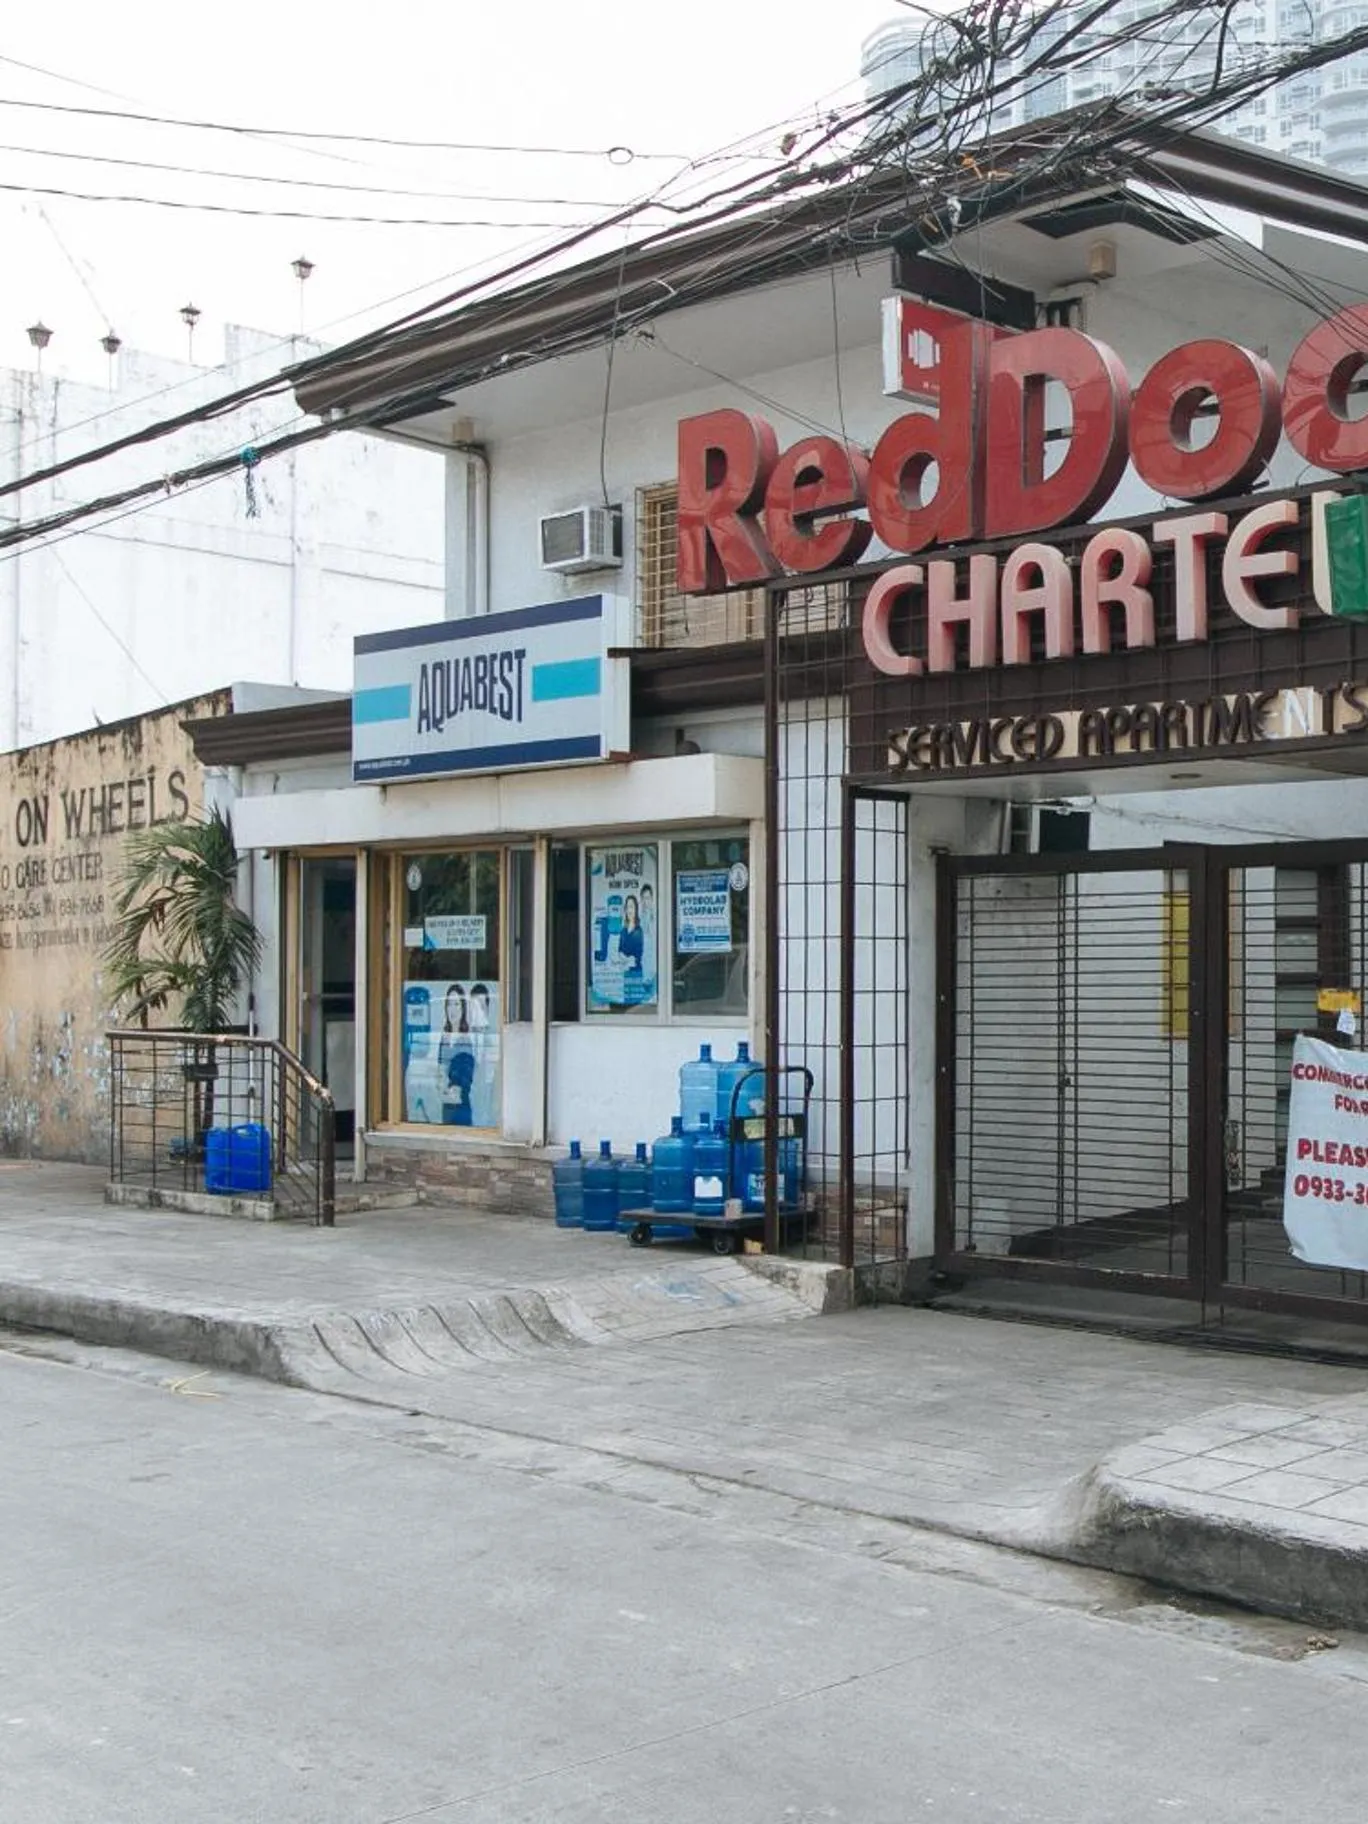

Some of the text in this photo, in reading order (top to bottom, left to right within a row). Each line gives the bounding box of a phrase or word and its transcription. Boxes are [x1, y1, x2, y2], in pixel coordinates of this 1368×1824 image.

[417, 648, 526, 735] AQUABEST
[887, 711, 1066, 773] SERVICED
[16, 768, 189, 847] ON WHEELS
[16, 854, 47, 889] CARE
[53, 851, 103, 884] CENTER
[604, 852, 644, 878] AQUABEST
[683, 906, 725, 916] COMPANY
